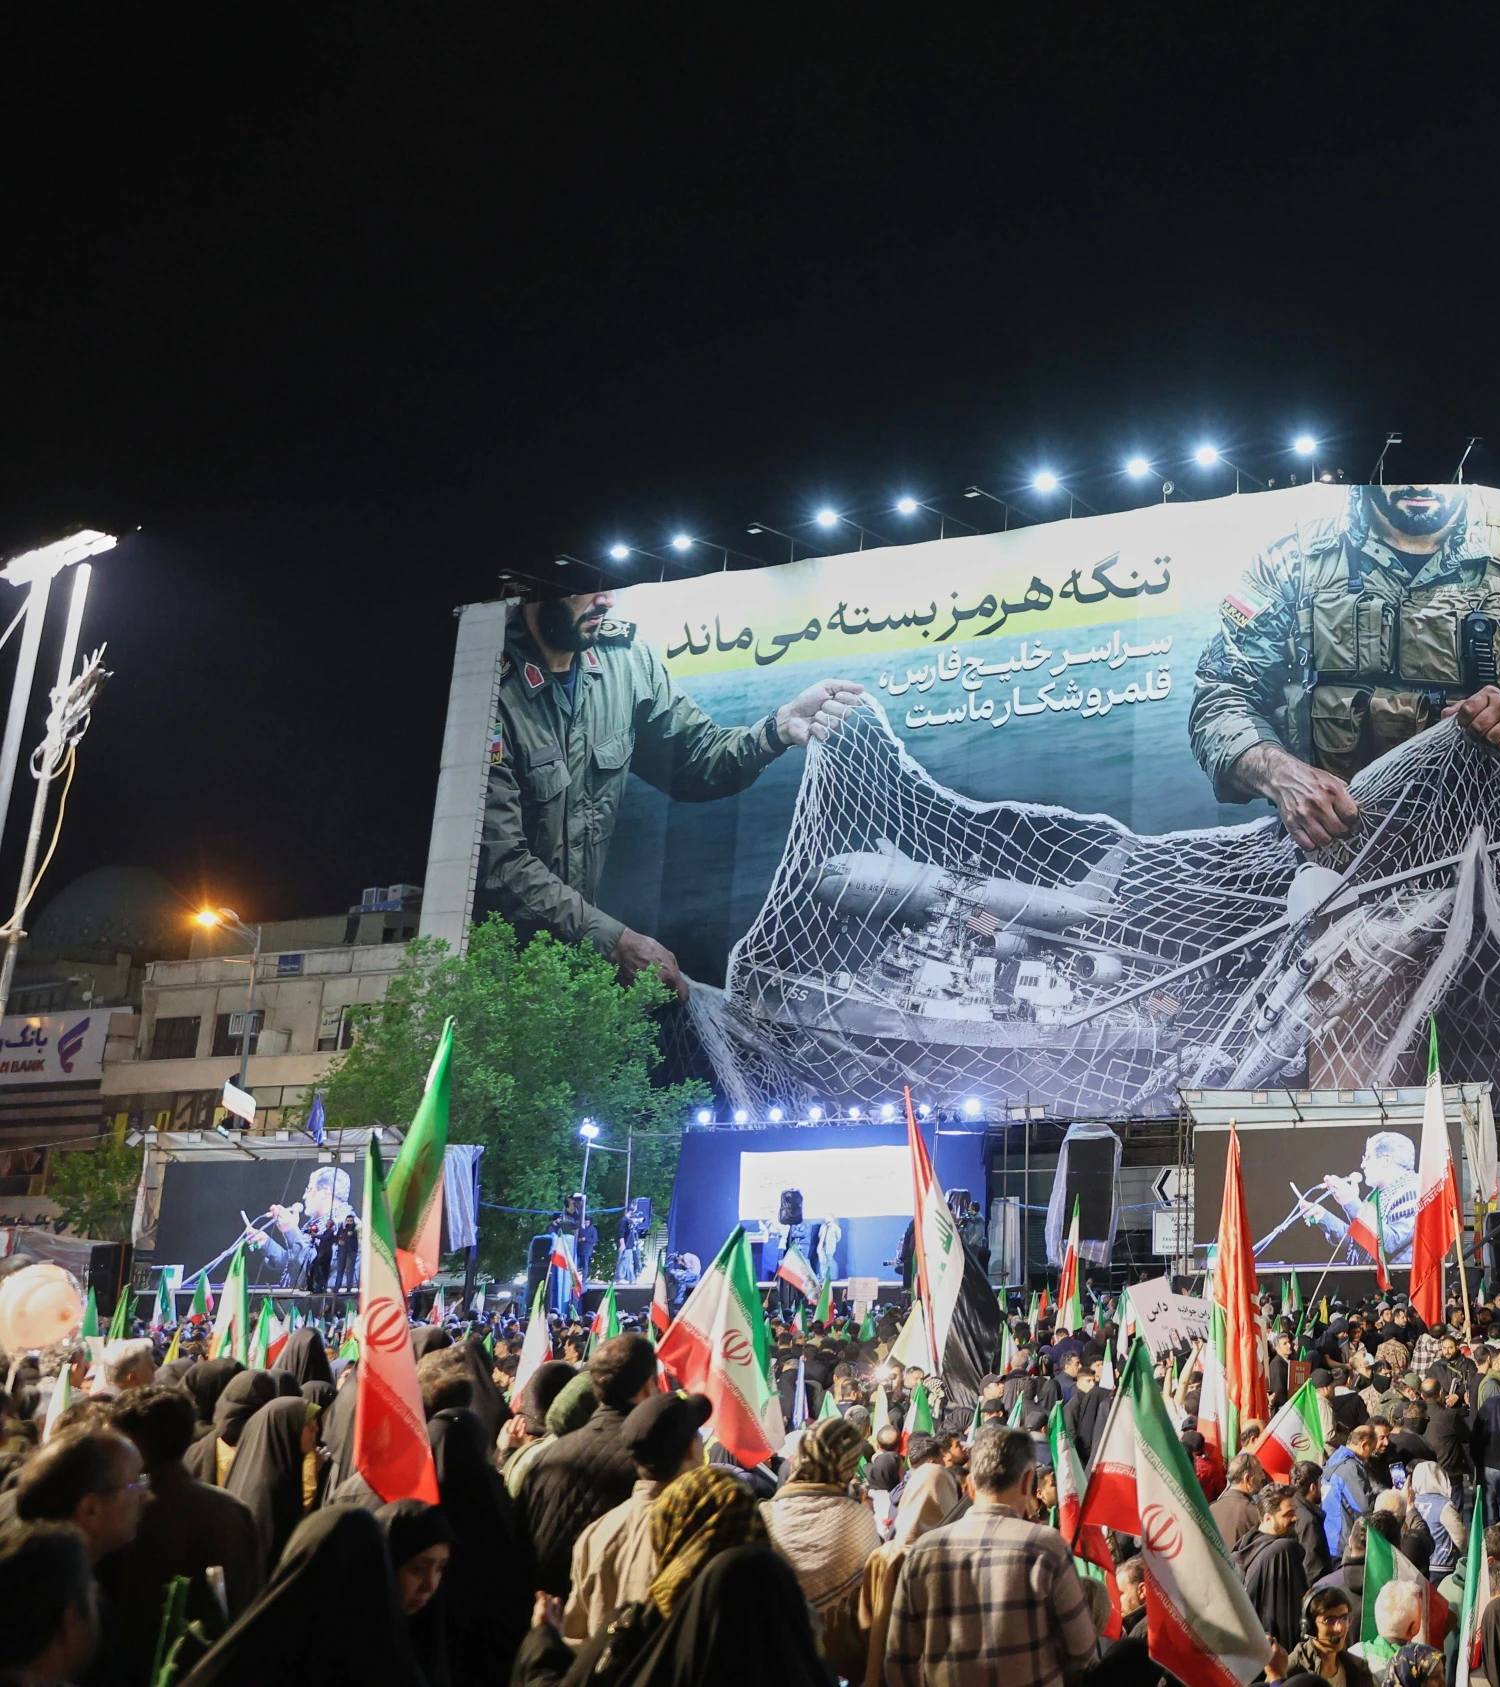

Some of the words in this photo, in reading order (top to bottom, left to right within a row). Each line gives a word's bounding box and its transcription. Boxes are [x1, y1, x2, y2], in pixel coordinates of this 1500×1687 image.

[1059, 551, 1172, 604] تنگه
[826, 600, 938, 640] بسته
[933, 575, 1054, 643] هرمز
[961, 639, 1053, 691] خلیج
[1050, 629, 1173, 676] سراسر
[904, 691, 994, 729] ماست
[991, 678, 1083, 728] شکار
[1080, 663, 1172, 719] قلمرو
[5, 1024, 48, 1054] بانک
[10, 1059, 45, 1073] BANK
[1147, 1302, 1169, 1323] داس
